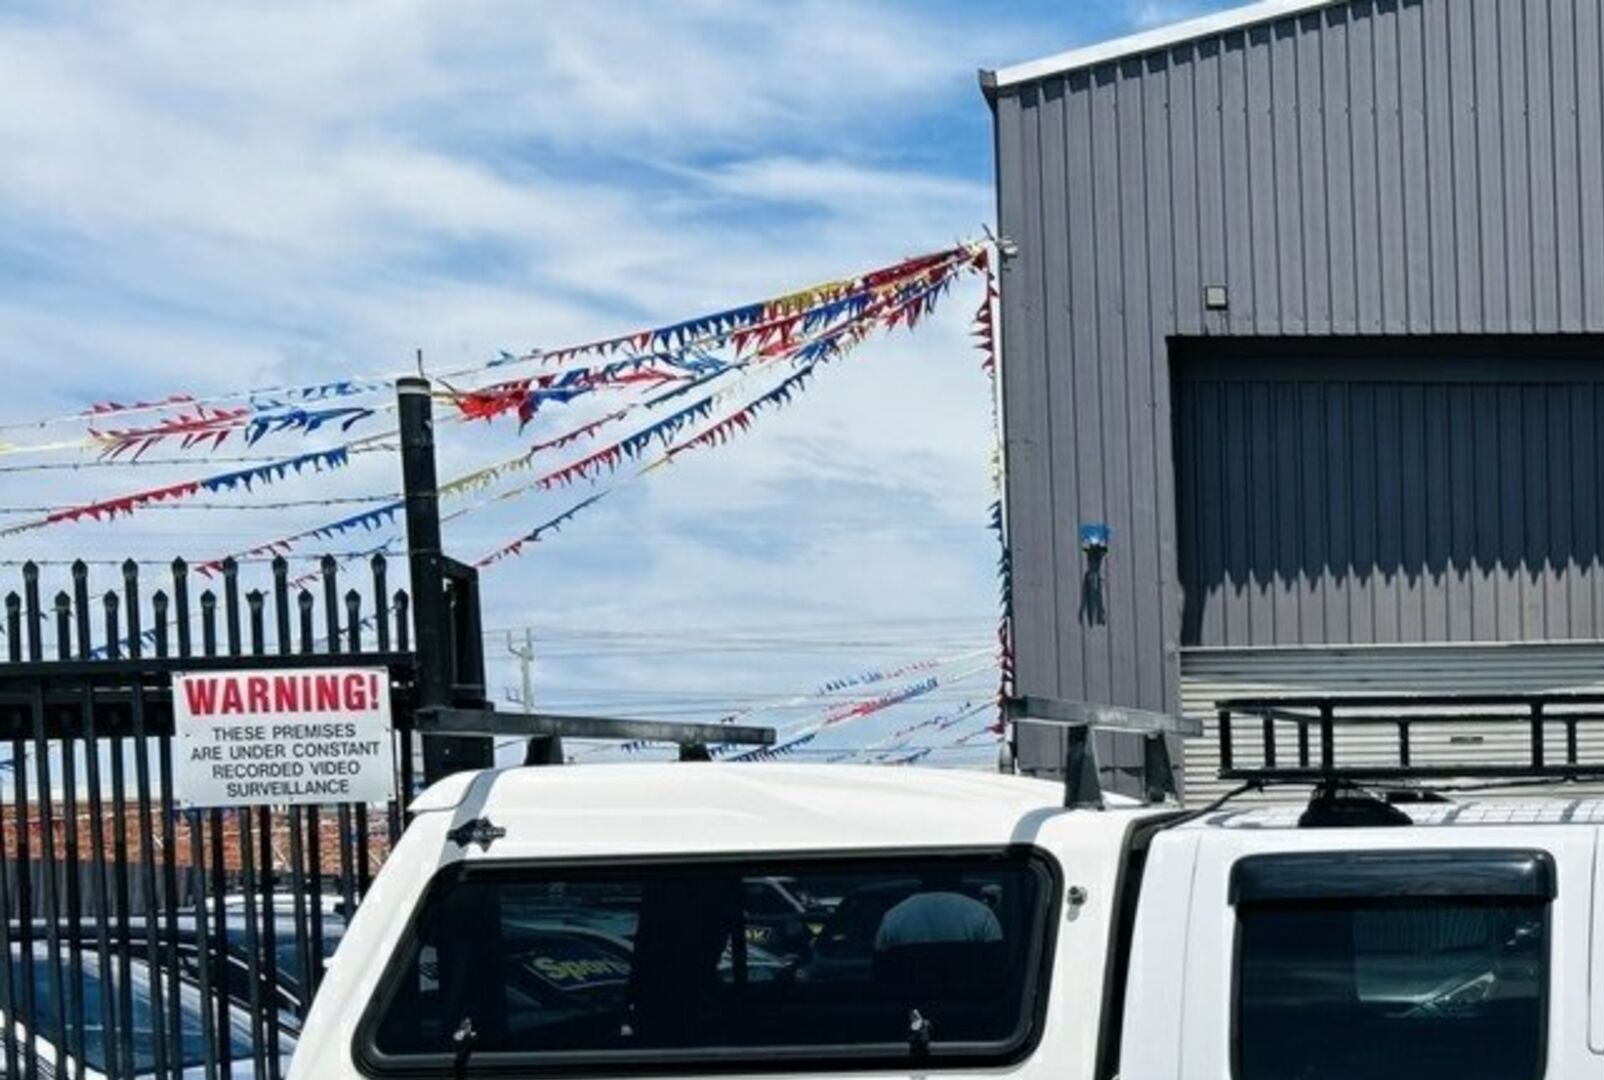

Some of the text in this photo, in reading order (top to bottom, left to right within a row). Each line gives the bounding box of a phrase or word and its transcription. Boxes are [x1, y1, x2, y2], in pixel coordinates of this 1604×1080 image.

[184, 673, 381, 716] WARNING!
[212, 723, 356, 742] THESE PREMISES
[190, 741, 380, 761] ARE UNDER CONSTANT
[212, 761, 361, 779] RECORDED VIDEO
[226, 779, 349, 797] SURVEILLANCE
